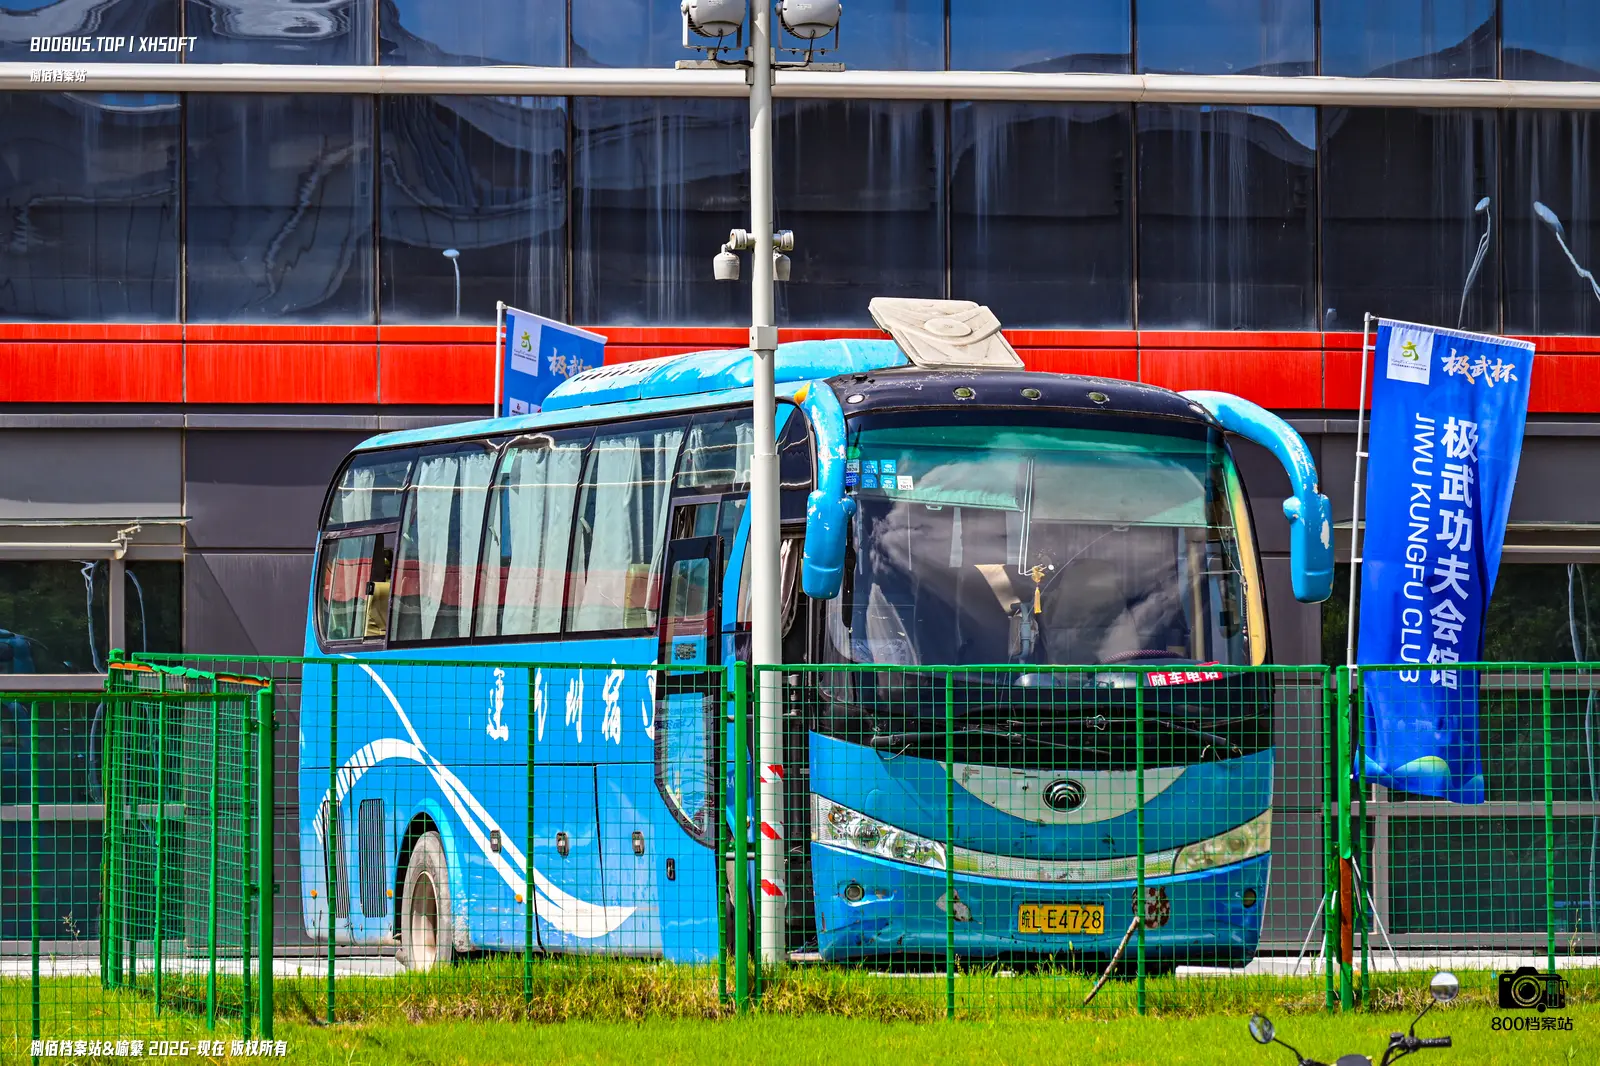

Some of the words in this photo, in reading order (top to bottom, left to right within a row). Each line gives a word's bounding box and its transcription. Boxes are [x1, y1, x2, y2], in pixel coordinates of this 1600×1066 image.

[1441, 348, 1518, 387] 极武杯
[1412, 413, 1435, 477] JIWU
[1403, 482, 1432, 601] KUNGFU
[1426, 416, 1480, 690] 极武功夫会馆
[1399, 608, 1423, 683] CLUB
